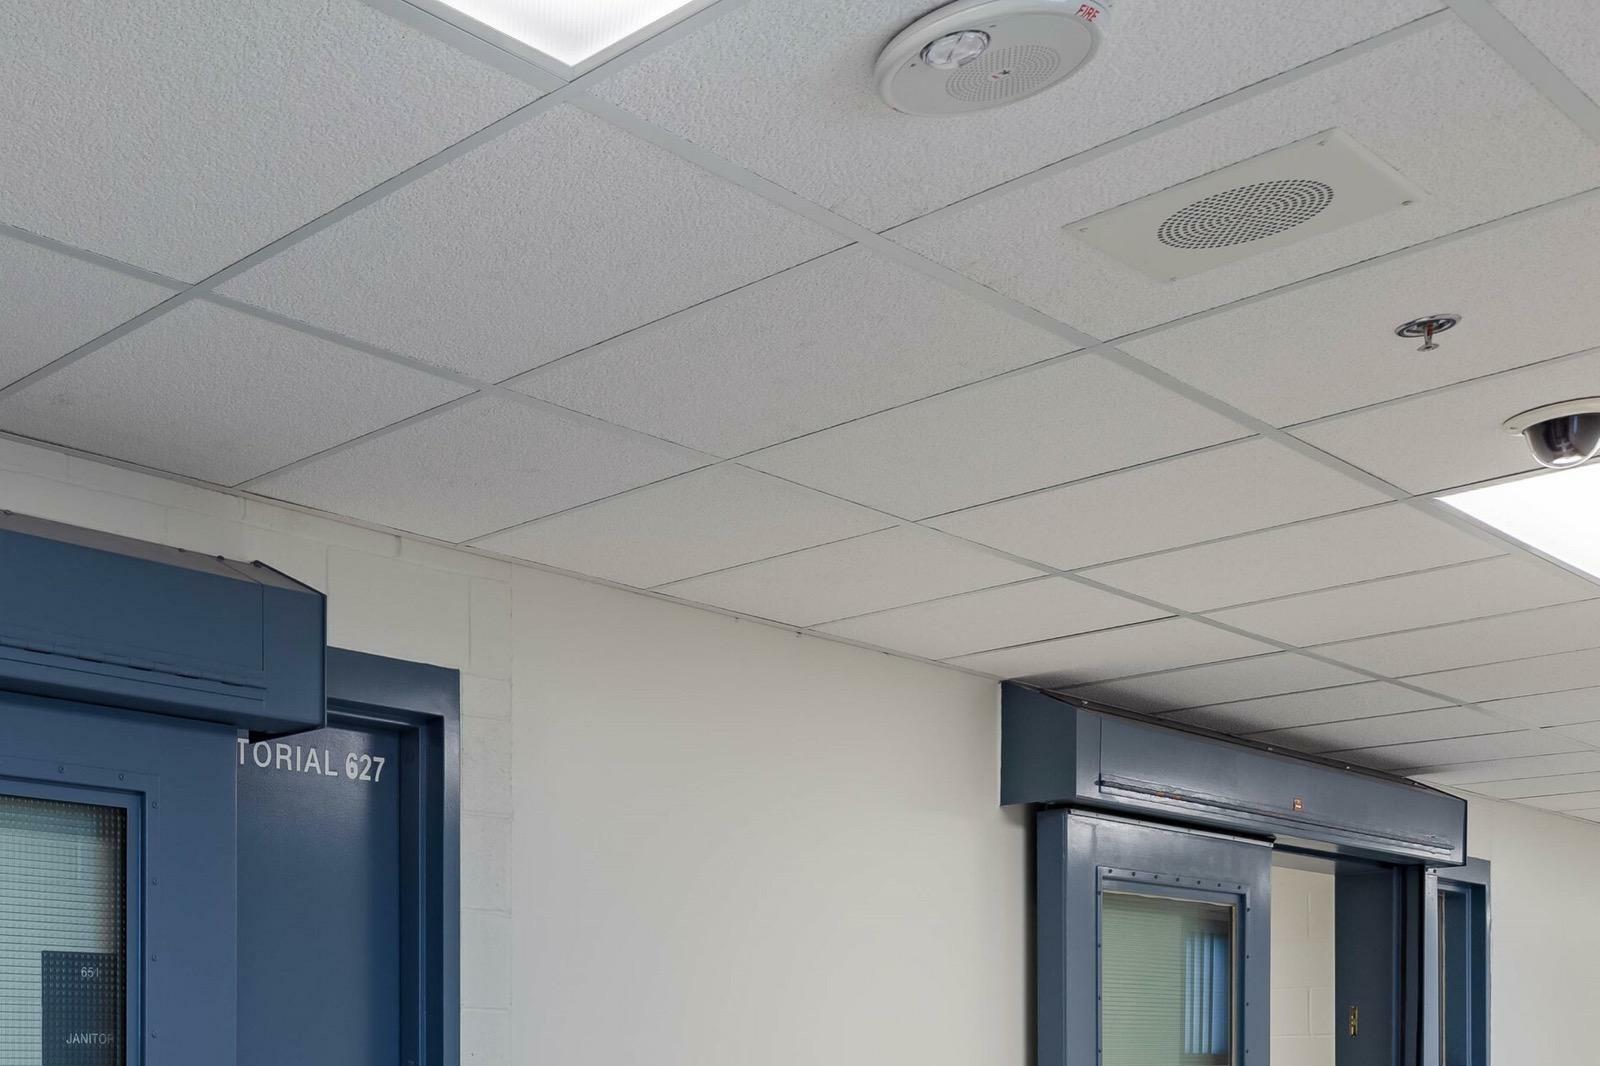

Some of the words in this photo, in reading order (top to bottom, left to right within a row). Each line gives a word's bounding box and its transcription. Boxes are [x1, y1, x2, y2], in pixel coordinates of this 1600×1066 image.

[1074, 4, 1100, 22] FIRE
[237, 738, 338, 777] TORIAL
[345, 752, 386, 782] 627
